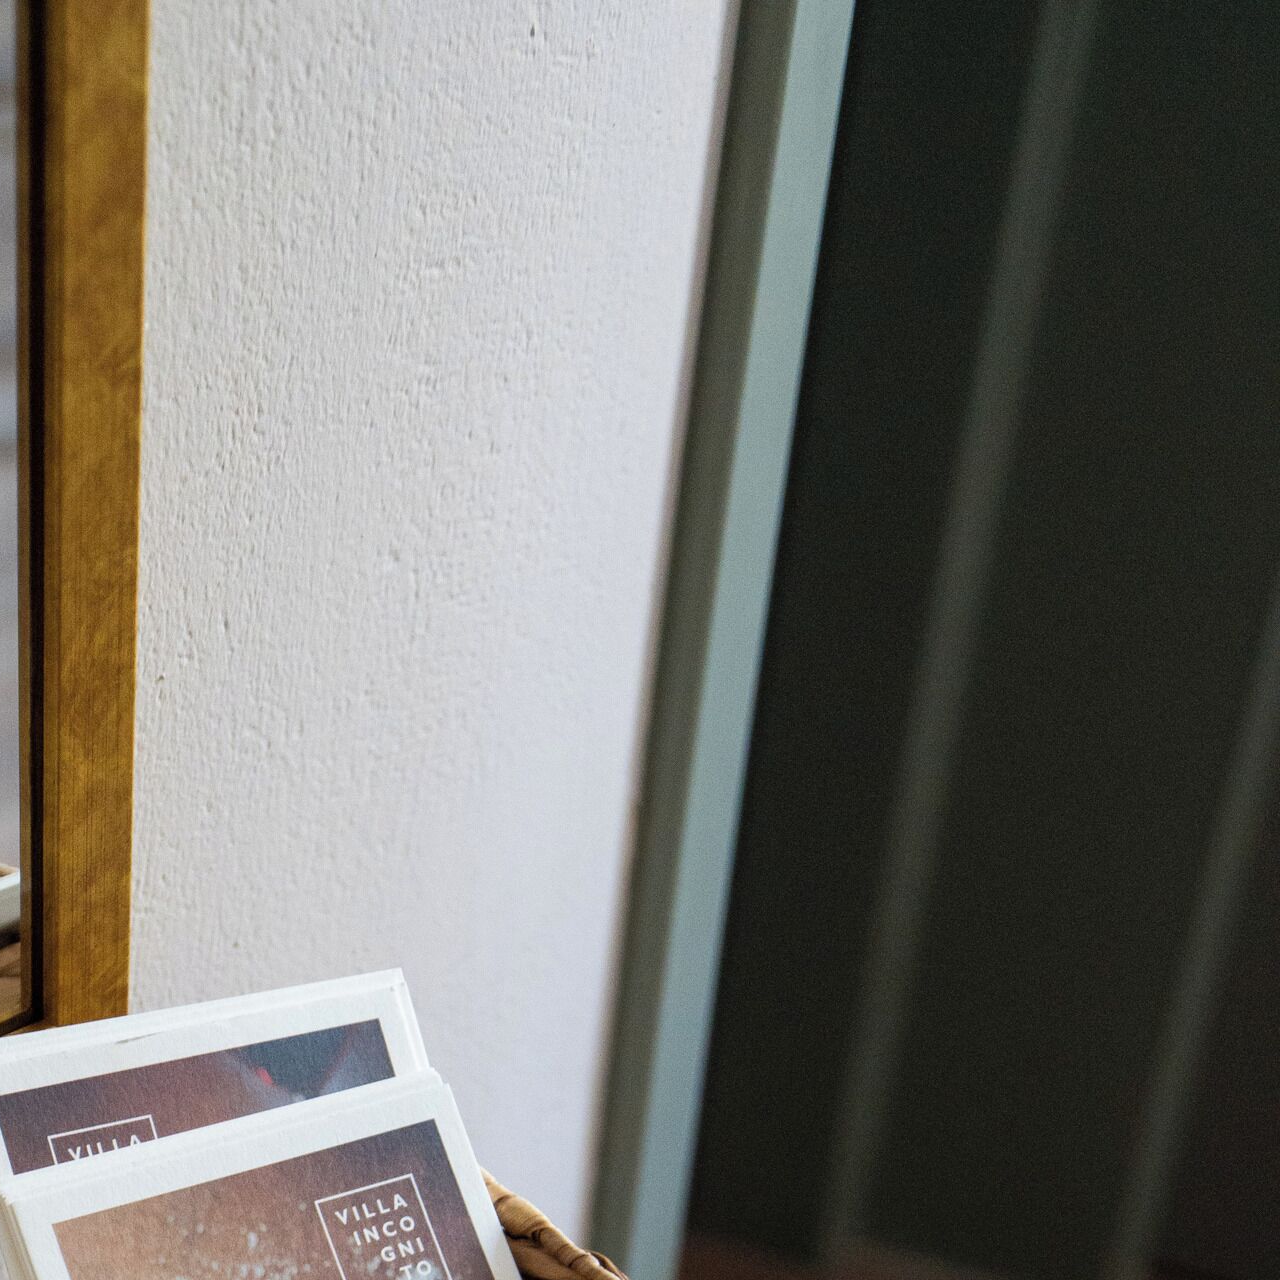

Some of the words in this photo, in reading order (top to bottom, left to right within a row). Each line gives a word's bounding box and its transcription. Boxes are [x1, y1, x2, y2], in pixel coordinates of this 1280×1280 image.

[334, 1194, 408, 1225] VILLA
[353, 1216, 415, 1246] INCO
[380, 1237, 425, 1262] GNI
[399, 1260, 432, 1280] TO
